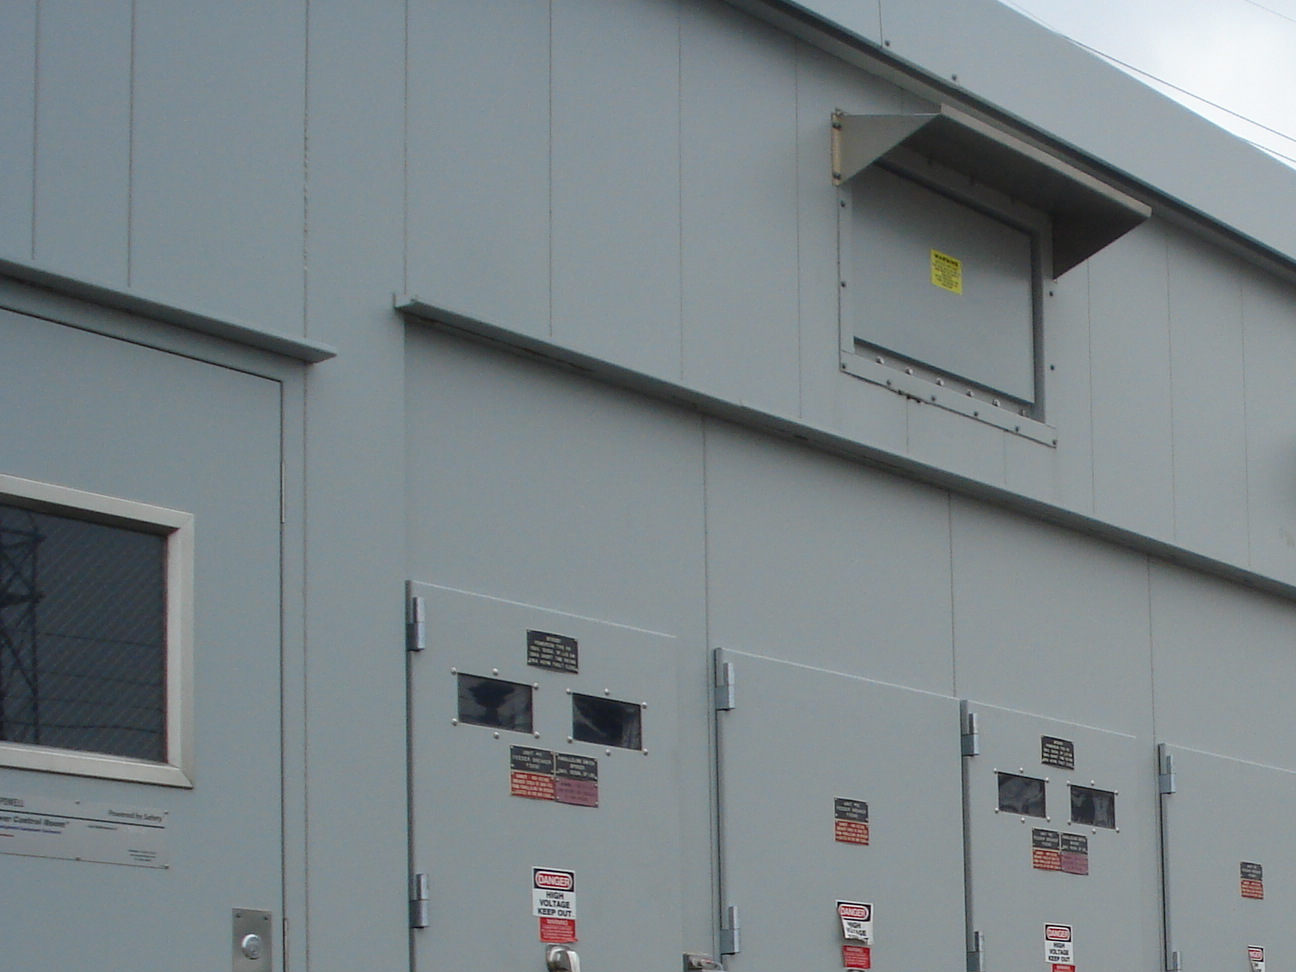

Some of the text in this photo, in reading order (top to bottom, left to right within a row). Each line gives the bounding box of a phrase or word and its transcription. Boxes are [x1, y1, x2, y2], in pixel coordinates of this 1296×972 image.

[538, 874, 571, 887] DANGER
[546, 891, 564, 900] HIGH
[539, 899, 570, 909] VOLTAGE
[538, 908, 572, 918] KEEP OUT
